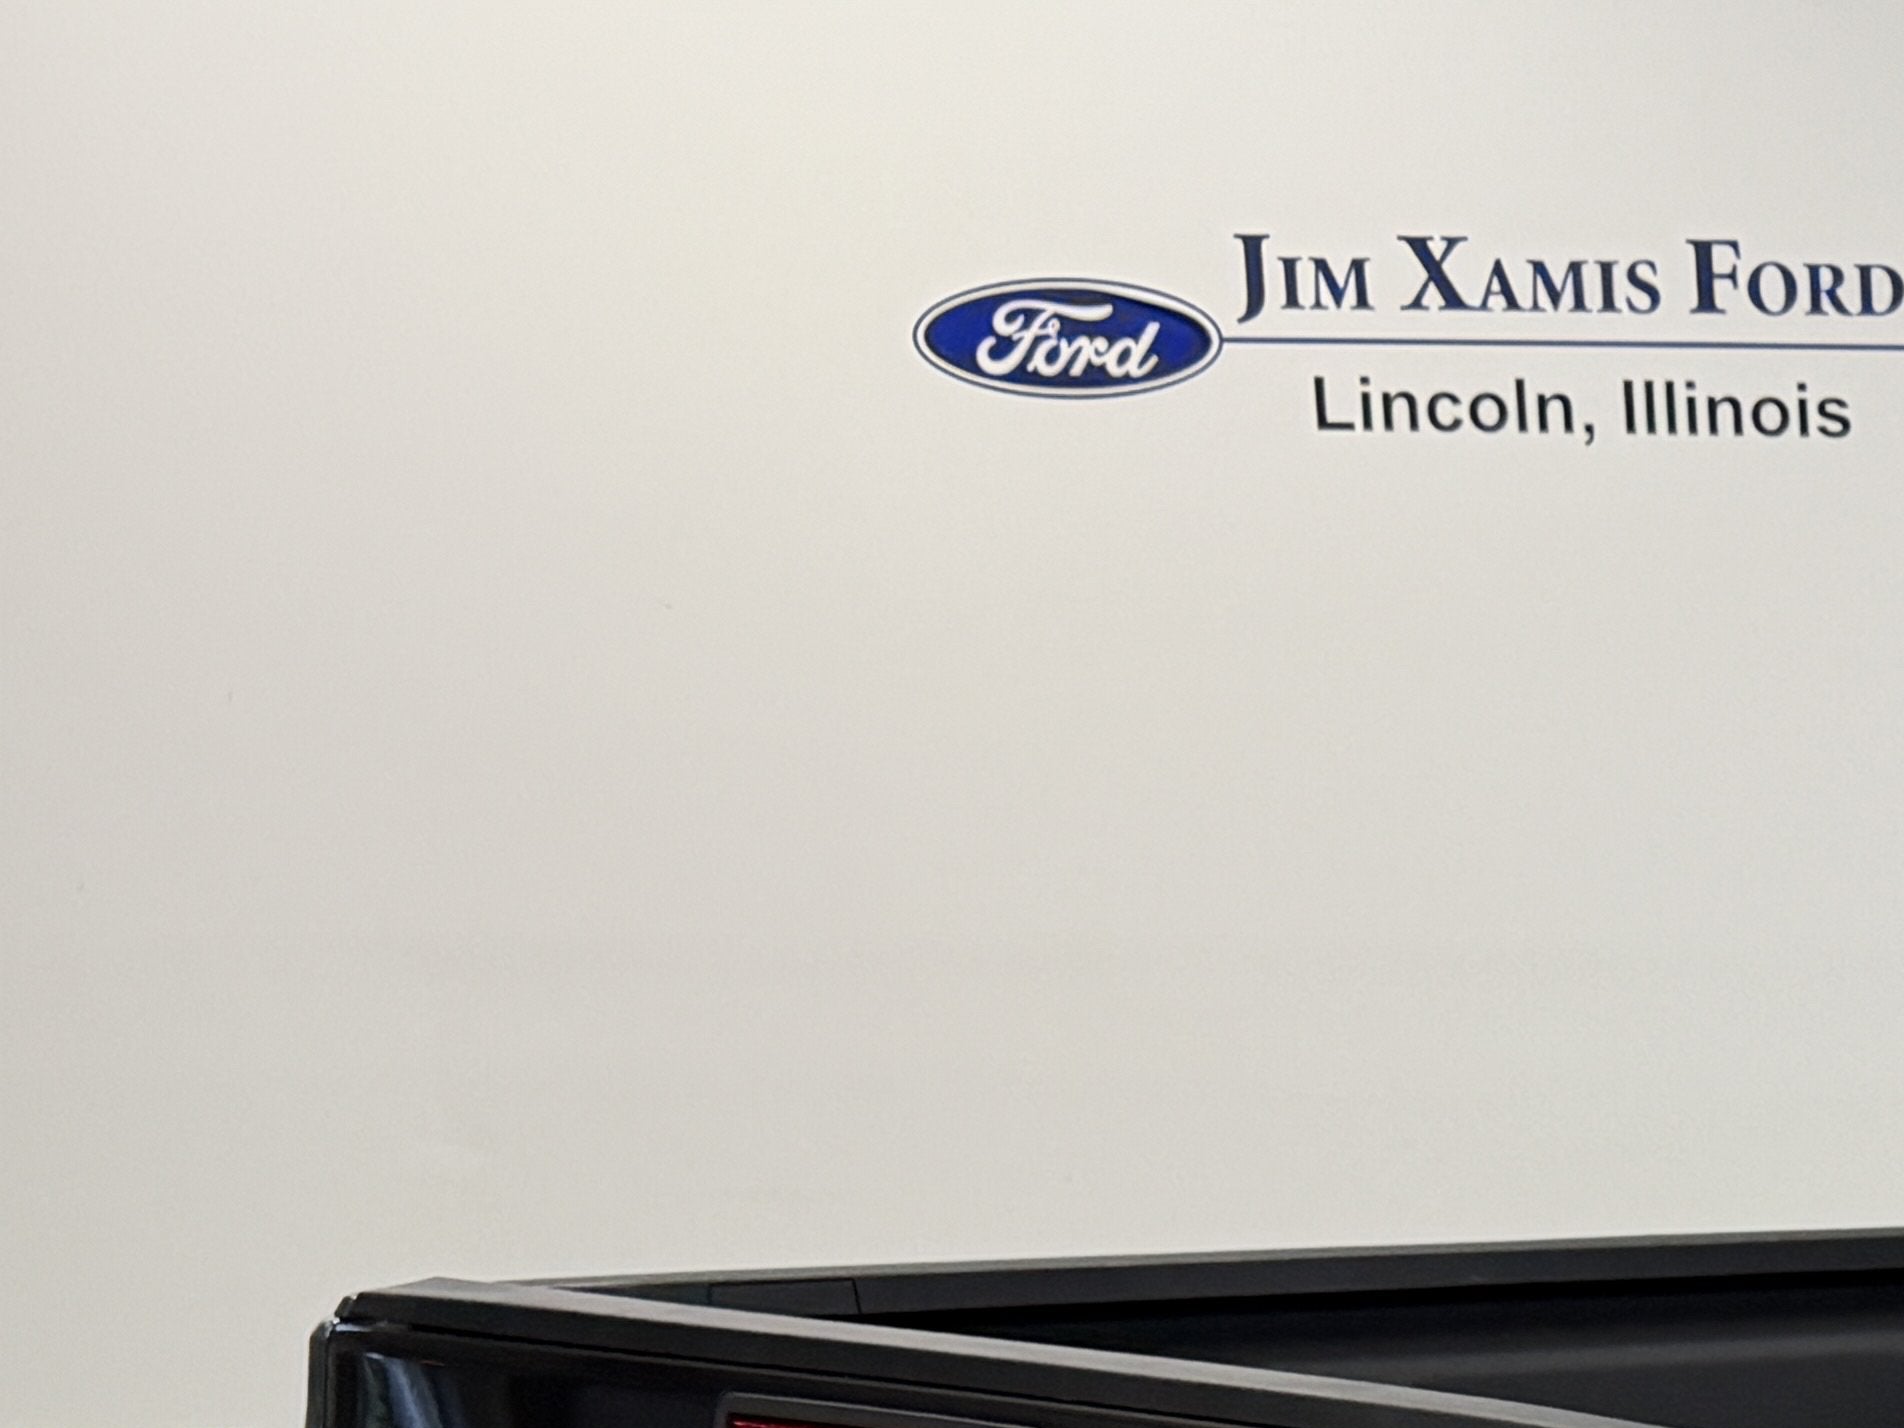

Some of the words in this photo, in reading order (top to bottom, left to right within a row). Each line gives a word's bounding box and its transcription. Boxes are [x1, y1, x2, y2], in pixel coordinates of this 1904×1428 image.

[1233, 233, 1375, 325] JIM
[1396, 235, 1661, 315] XAMIS
[976, 299, 1161, 378] Ford
[1313, 375, 1595, 446] Lincoln,
[1622, 379, 1852, 439] Illinois
